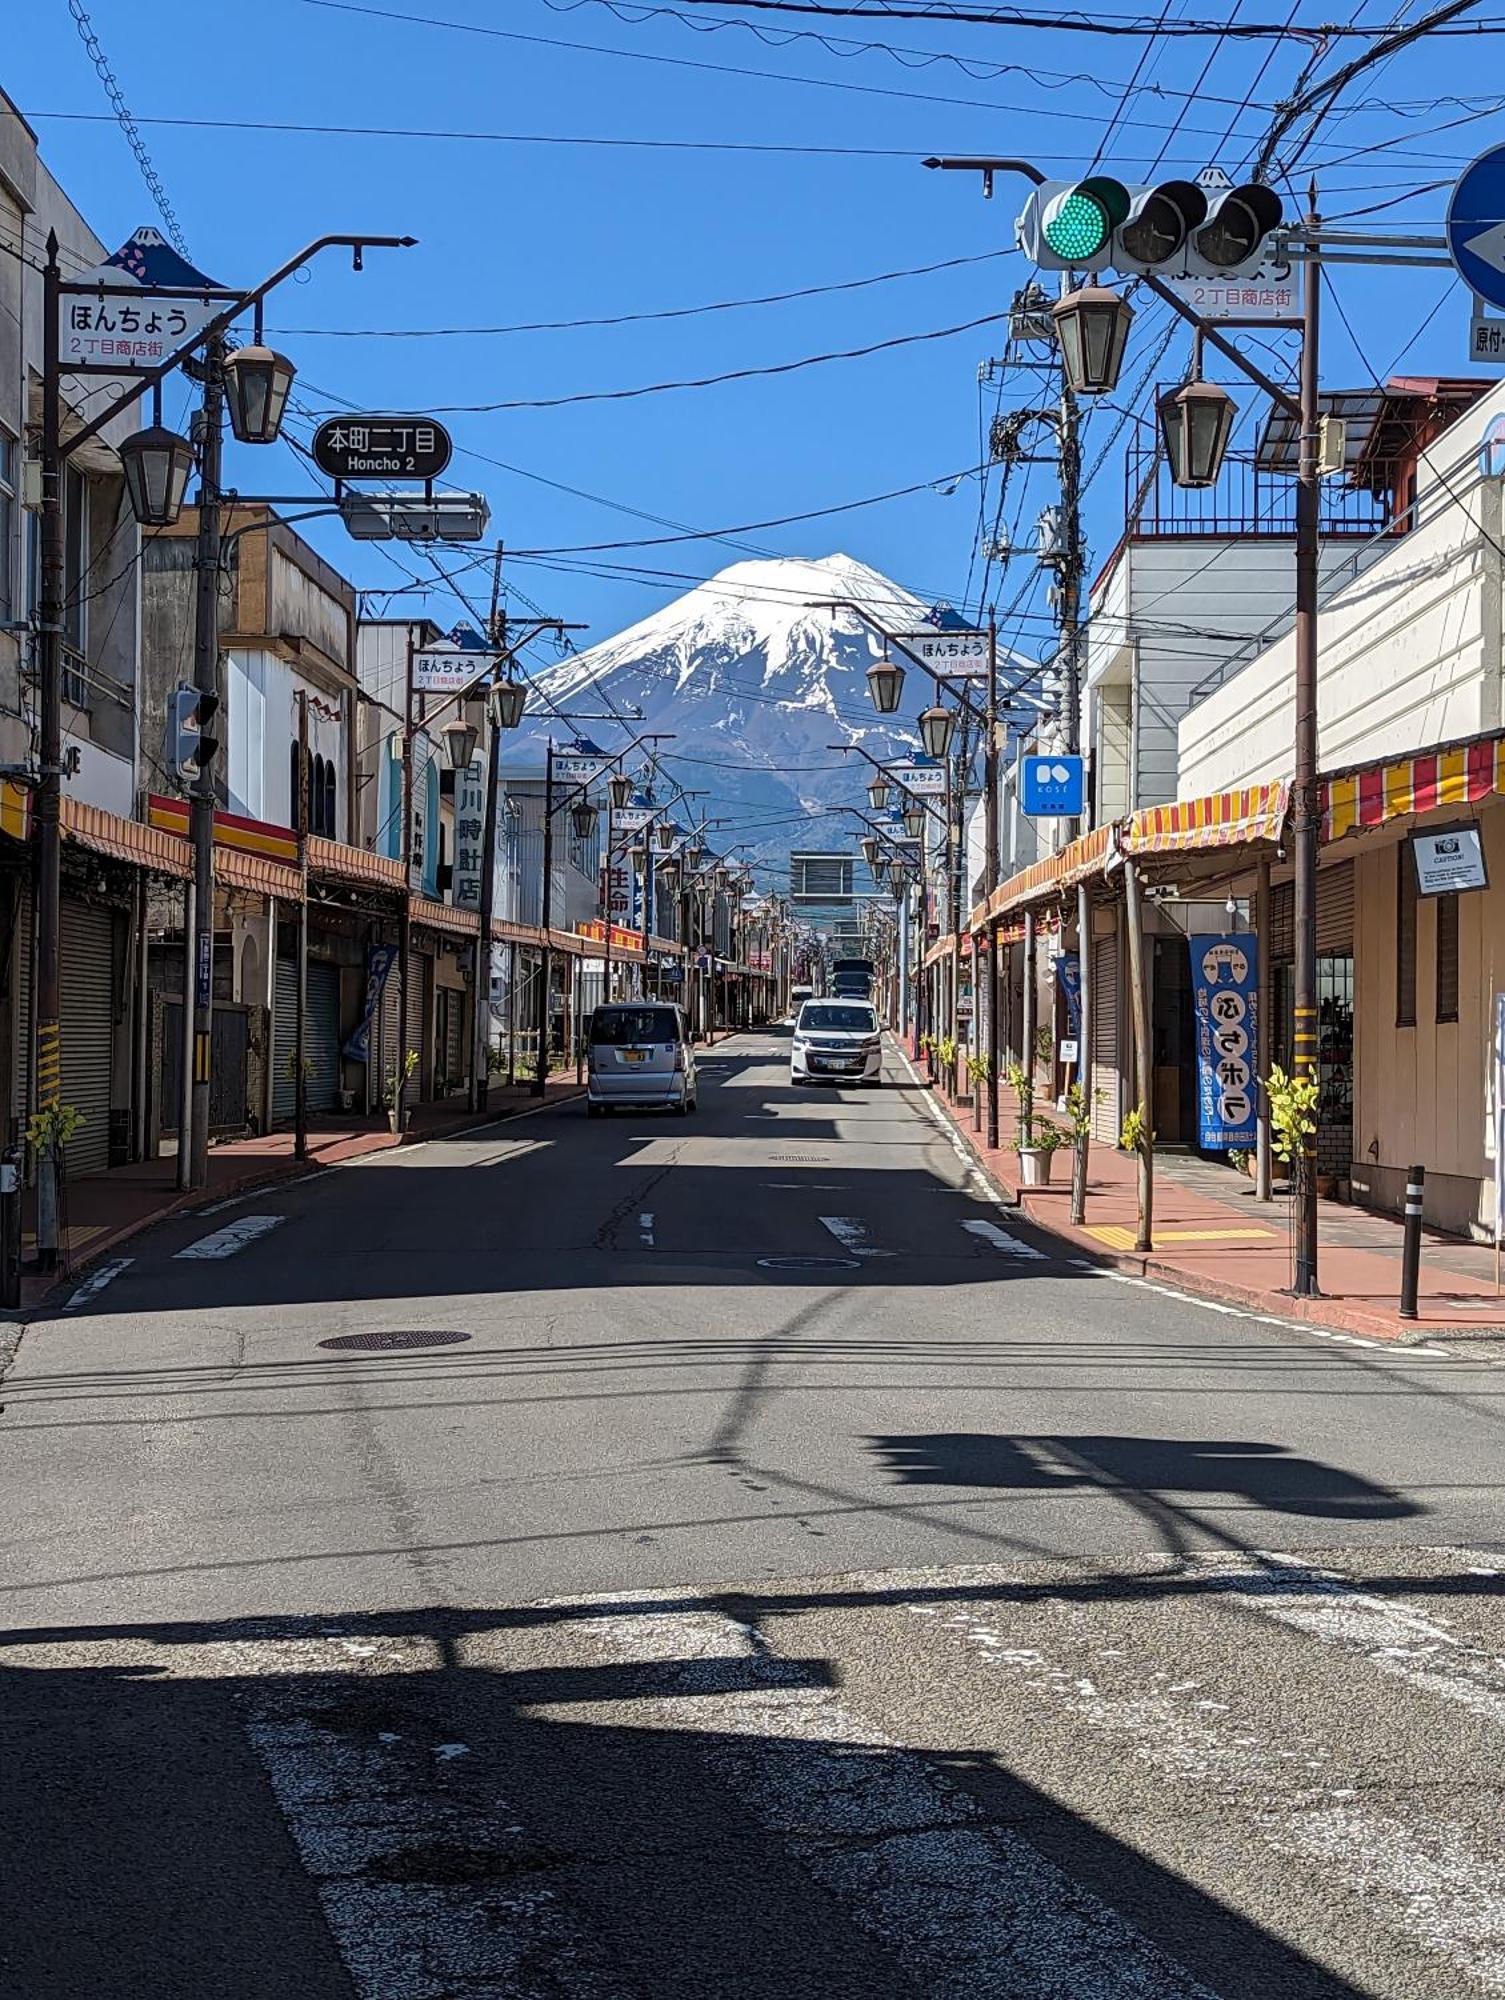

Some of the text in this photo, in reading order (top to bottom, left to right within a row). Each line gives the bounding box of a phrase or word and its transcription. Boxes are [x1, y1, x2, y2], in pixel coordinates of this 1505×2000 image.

[1194, 287, 1291, 305] 2丁目商店街
[71, 305, 187, 335] ほんちょう
[70, 338, 163, 356] 2丁目商店街
[327, 426, 435, 453] 本町二丁目
[348, 456, 415, 470] Honcho 2
[923, 642, 983, 657] ほんちょう
[418, 660, 476, 674] ほんちょう
